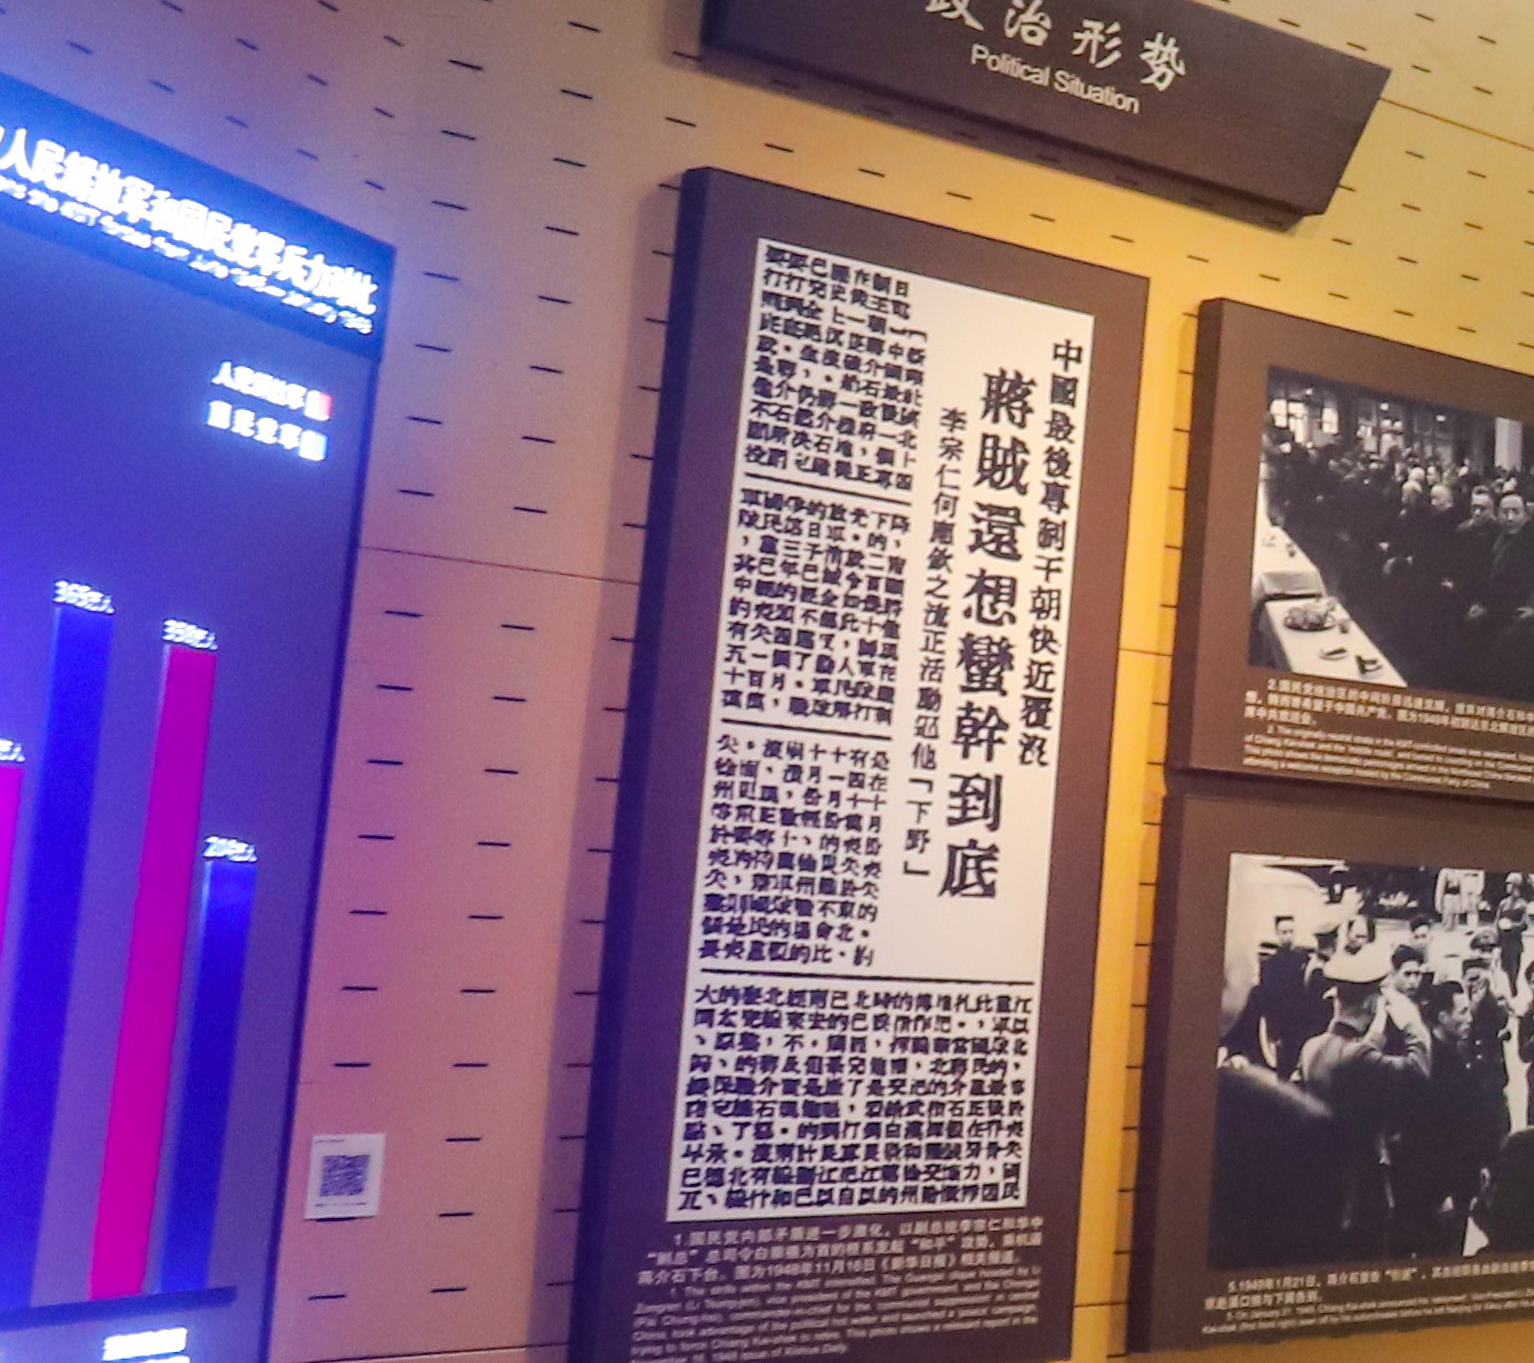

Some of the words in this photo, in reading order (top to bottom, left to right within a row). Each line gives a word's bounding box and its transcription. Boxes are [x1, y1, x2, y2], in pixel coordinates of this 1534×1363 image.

[971, 42, 1050, 89] Political
[1054, 68, 1140, 114] Situation
[938, 369, 1036, 899] 蔣賊還想蠻幹到底
